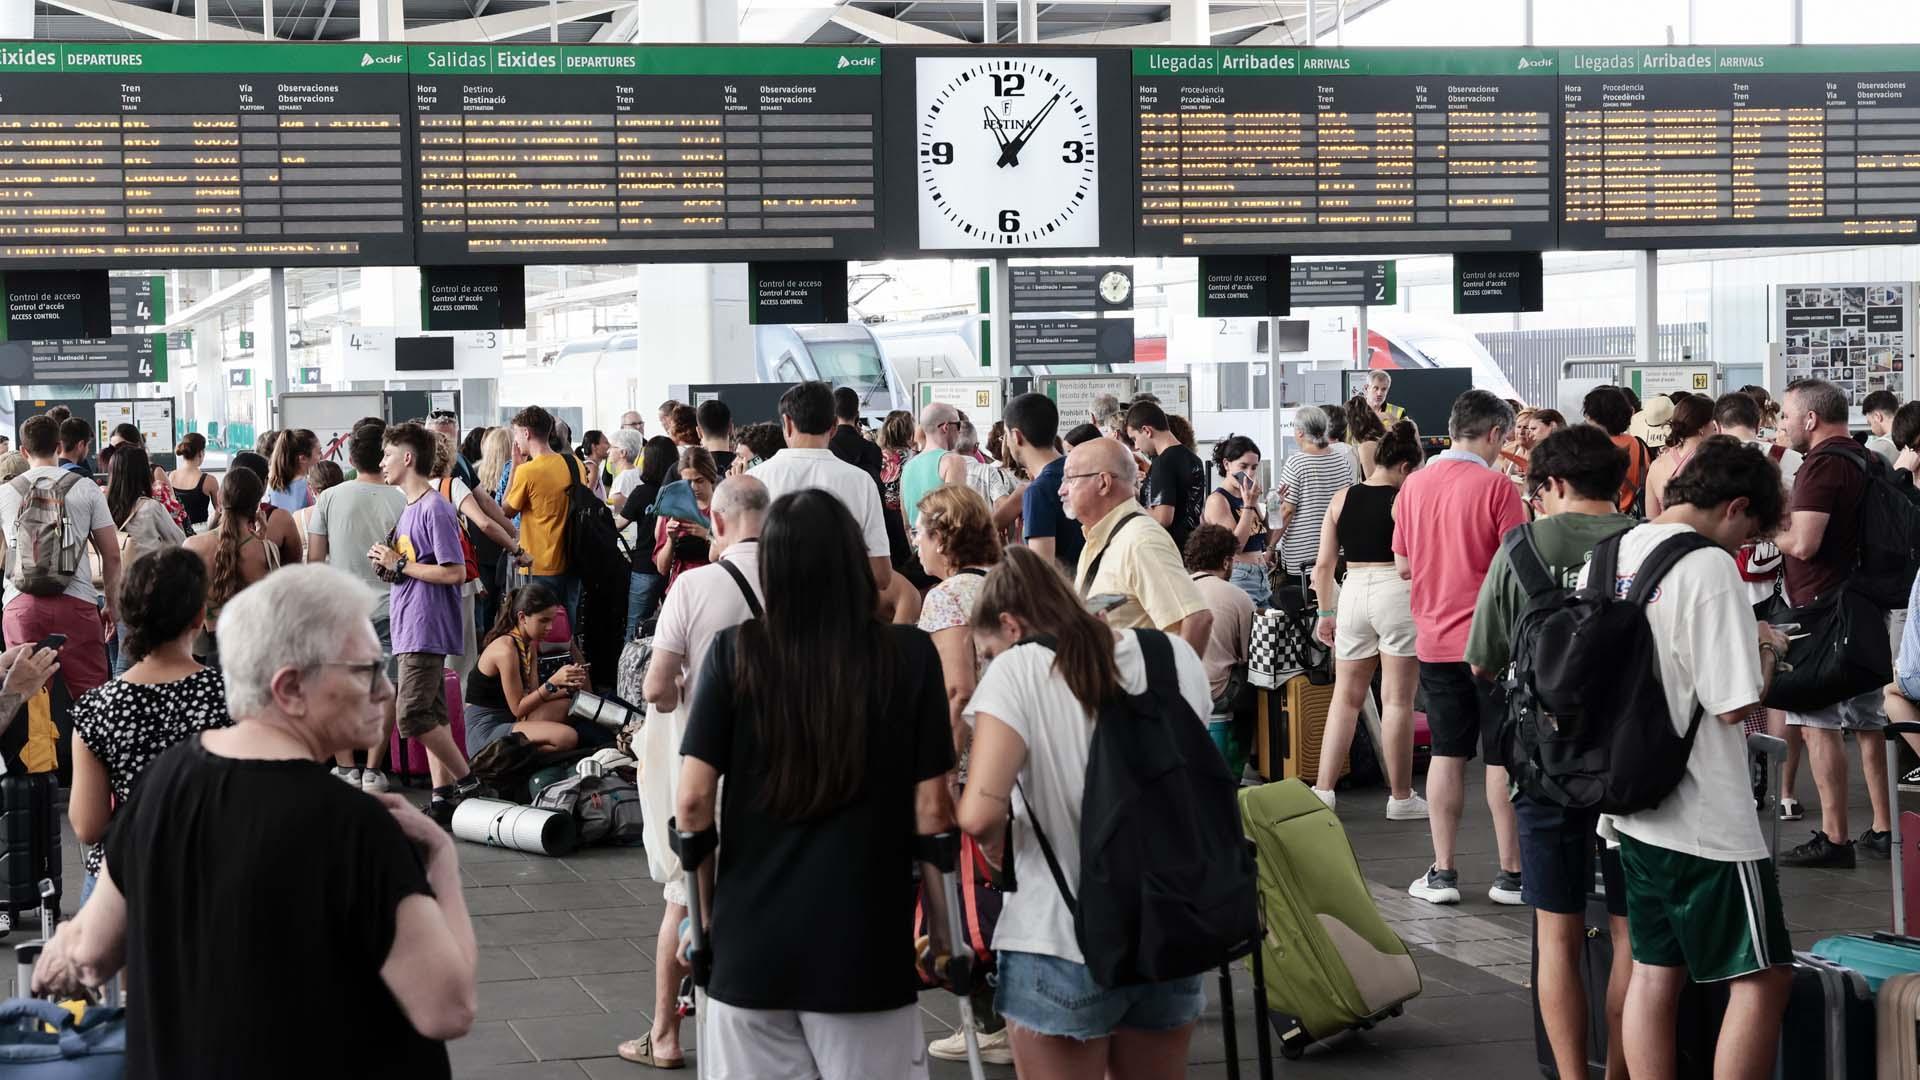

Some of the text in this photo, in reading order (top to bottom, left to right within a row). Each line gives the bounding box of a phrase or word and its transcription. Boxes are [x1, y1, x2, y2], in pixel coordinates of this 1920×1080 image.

[0, 48, 142, 66] ixides DEPARTURES
[376, 54, 402, 64] adif
[428, 50, 636, 68] Salidas Eixides DEPARTURES
[848, 56, 876, 66] adif
[1150, 54, 1350, 72] Llegadas Arribades ARRIVALS
[1528, 58, 1552, 66] adif
[1574, 52, 1764, 72] Llegadas Arribades ARRIVALS
[120, 84, 140, 92] Tren
[278, 84, 338, 92] Observaciones
[418, 84, 436, 92] Hora
[989, 73, 1026, 97] 12
[1448, 84, 1498, 92] Observaciones
[1564, 84, 1582, 92] Hora
[1602, 84, 1644, 92] Procedencia
[1732, 82, 1748, 90] Tren
[1856, 80, 1906, 90] Observaciones
[464, 86, 494, 94] Destino
[616, 86, 634, 94] Tren
[760, 86, 816, 94] Observaciones
[1140, 86, 1158, 94] Hora
[1180, 86, 1224, 96] Procedencia
[1318, 86, 1334, 94] Tren
[1856, 90, 1902, 98] Observacions
[122, 94, 140, 102] Tren
[240, 94, 254, 102] Via
[278, 94, 334, 102] Observacions
[418, 96, 436, 104] Hora
[464, 96, 506, 104] Destinació
[616, 96, 634, 104] Tren
[724, 96, 738, 104] Via
[760, 94, 812, 104] Observacions
[1180, 94, 1224, 104] Procedència
[1416, 94, 1428, 102] Via
[1448, 94, 1496, 102] Observacions
[1602, 92, 1646, 100] Procedència
[1826, 92, 1838, 100] Via
[984, 120, 1032, 130] FESTINA
[932, 142, 954, 165] 9
[1062, 140, 1084, 164] 3
[998, 210, 1020, 232] 6
[1208, 274, 1232, 282] Control
[1462, 272, 1486, 280] Control
[760, 280, 784, 288] Control
[786, 280, 796, 288] de
[1230, 282, 1254, 290] d'accés
[432, 284, 458, 294] Control
[460, 284, 472, 292] de
[784, 288, 808, 296] d'accés
[1376, 283, 1384, 300] 2
[10, 293, 38, 301] Control
[136, 301, 151, 320] 4
[1220, 320, 1228, 334] 2
[1338, 316, 1346, 332] 1
[350, 334, 362, 351] 4
[487, 331, 496, 349] 3
[138, 358, 152, 377] 4
